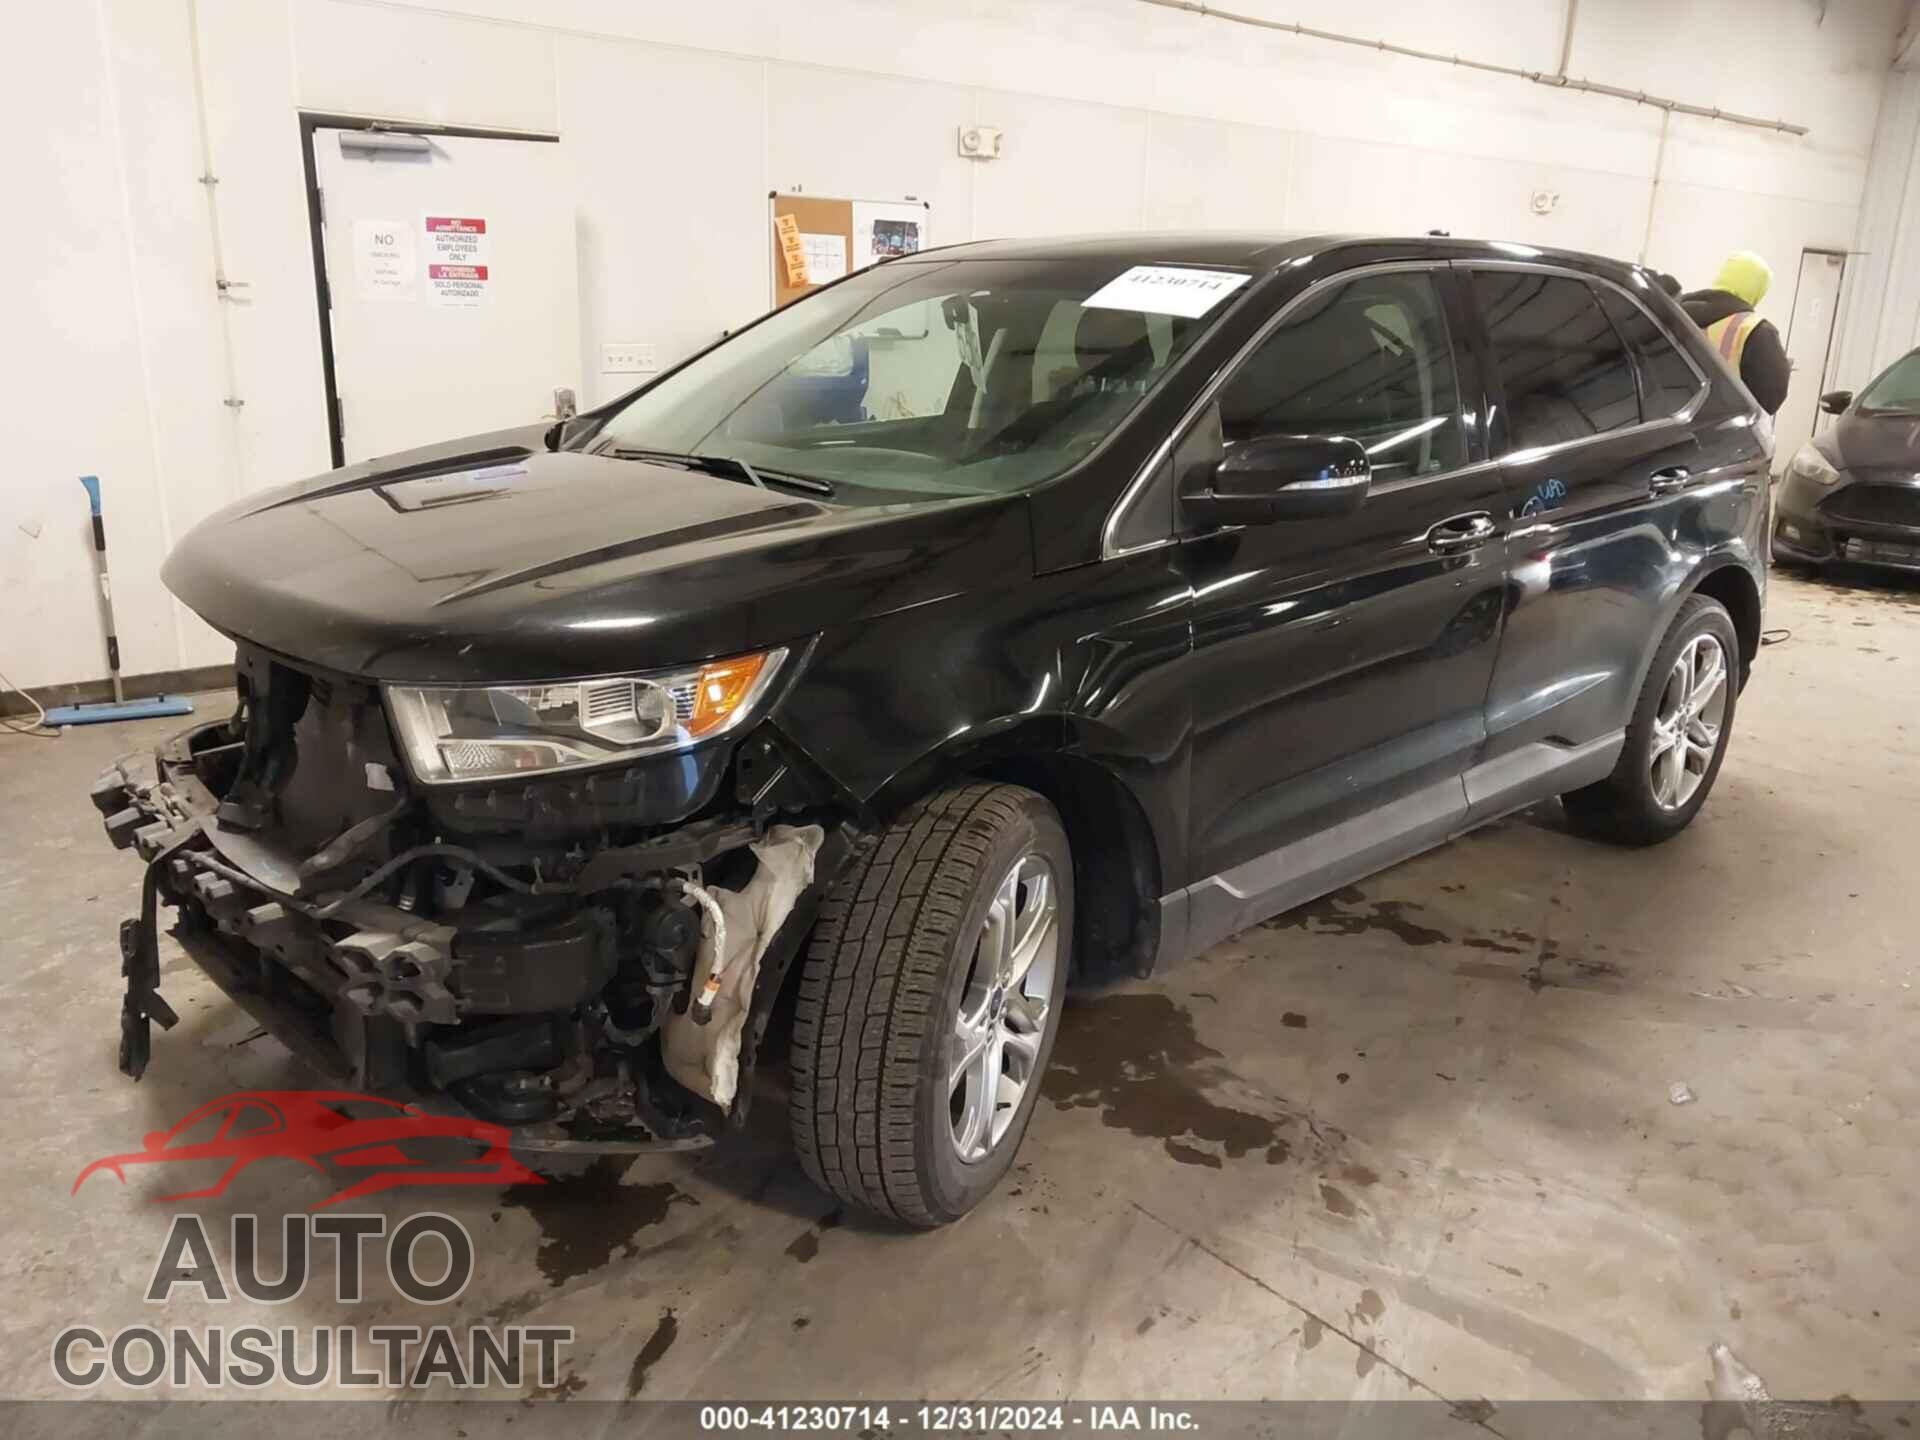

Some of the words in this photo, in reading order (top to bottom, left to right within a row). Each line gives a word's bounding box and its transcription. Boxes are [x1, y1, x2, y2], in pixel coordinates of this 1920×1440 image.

[374, 233, 394, 246] NO
[435, 234, 478, 243] AUTHORIZED
[436, 243, 477, 252] EMPLOYEES
[448, 252, 466, 261] ONLY
